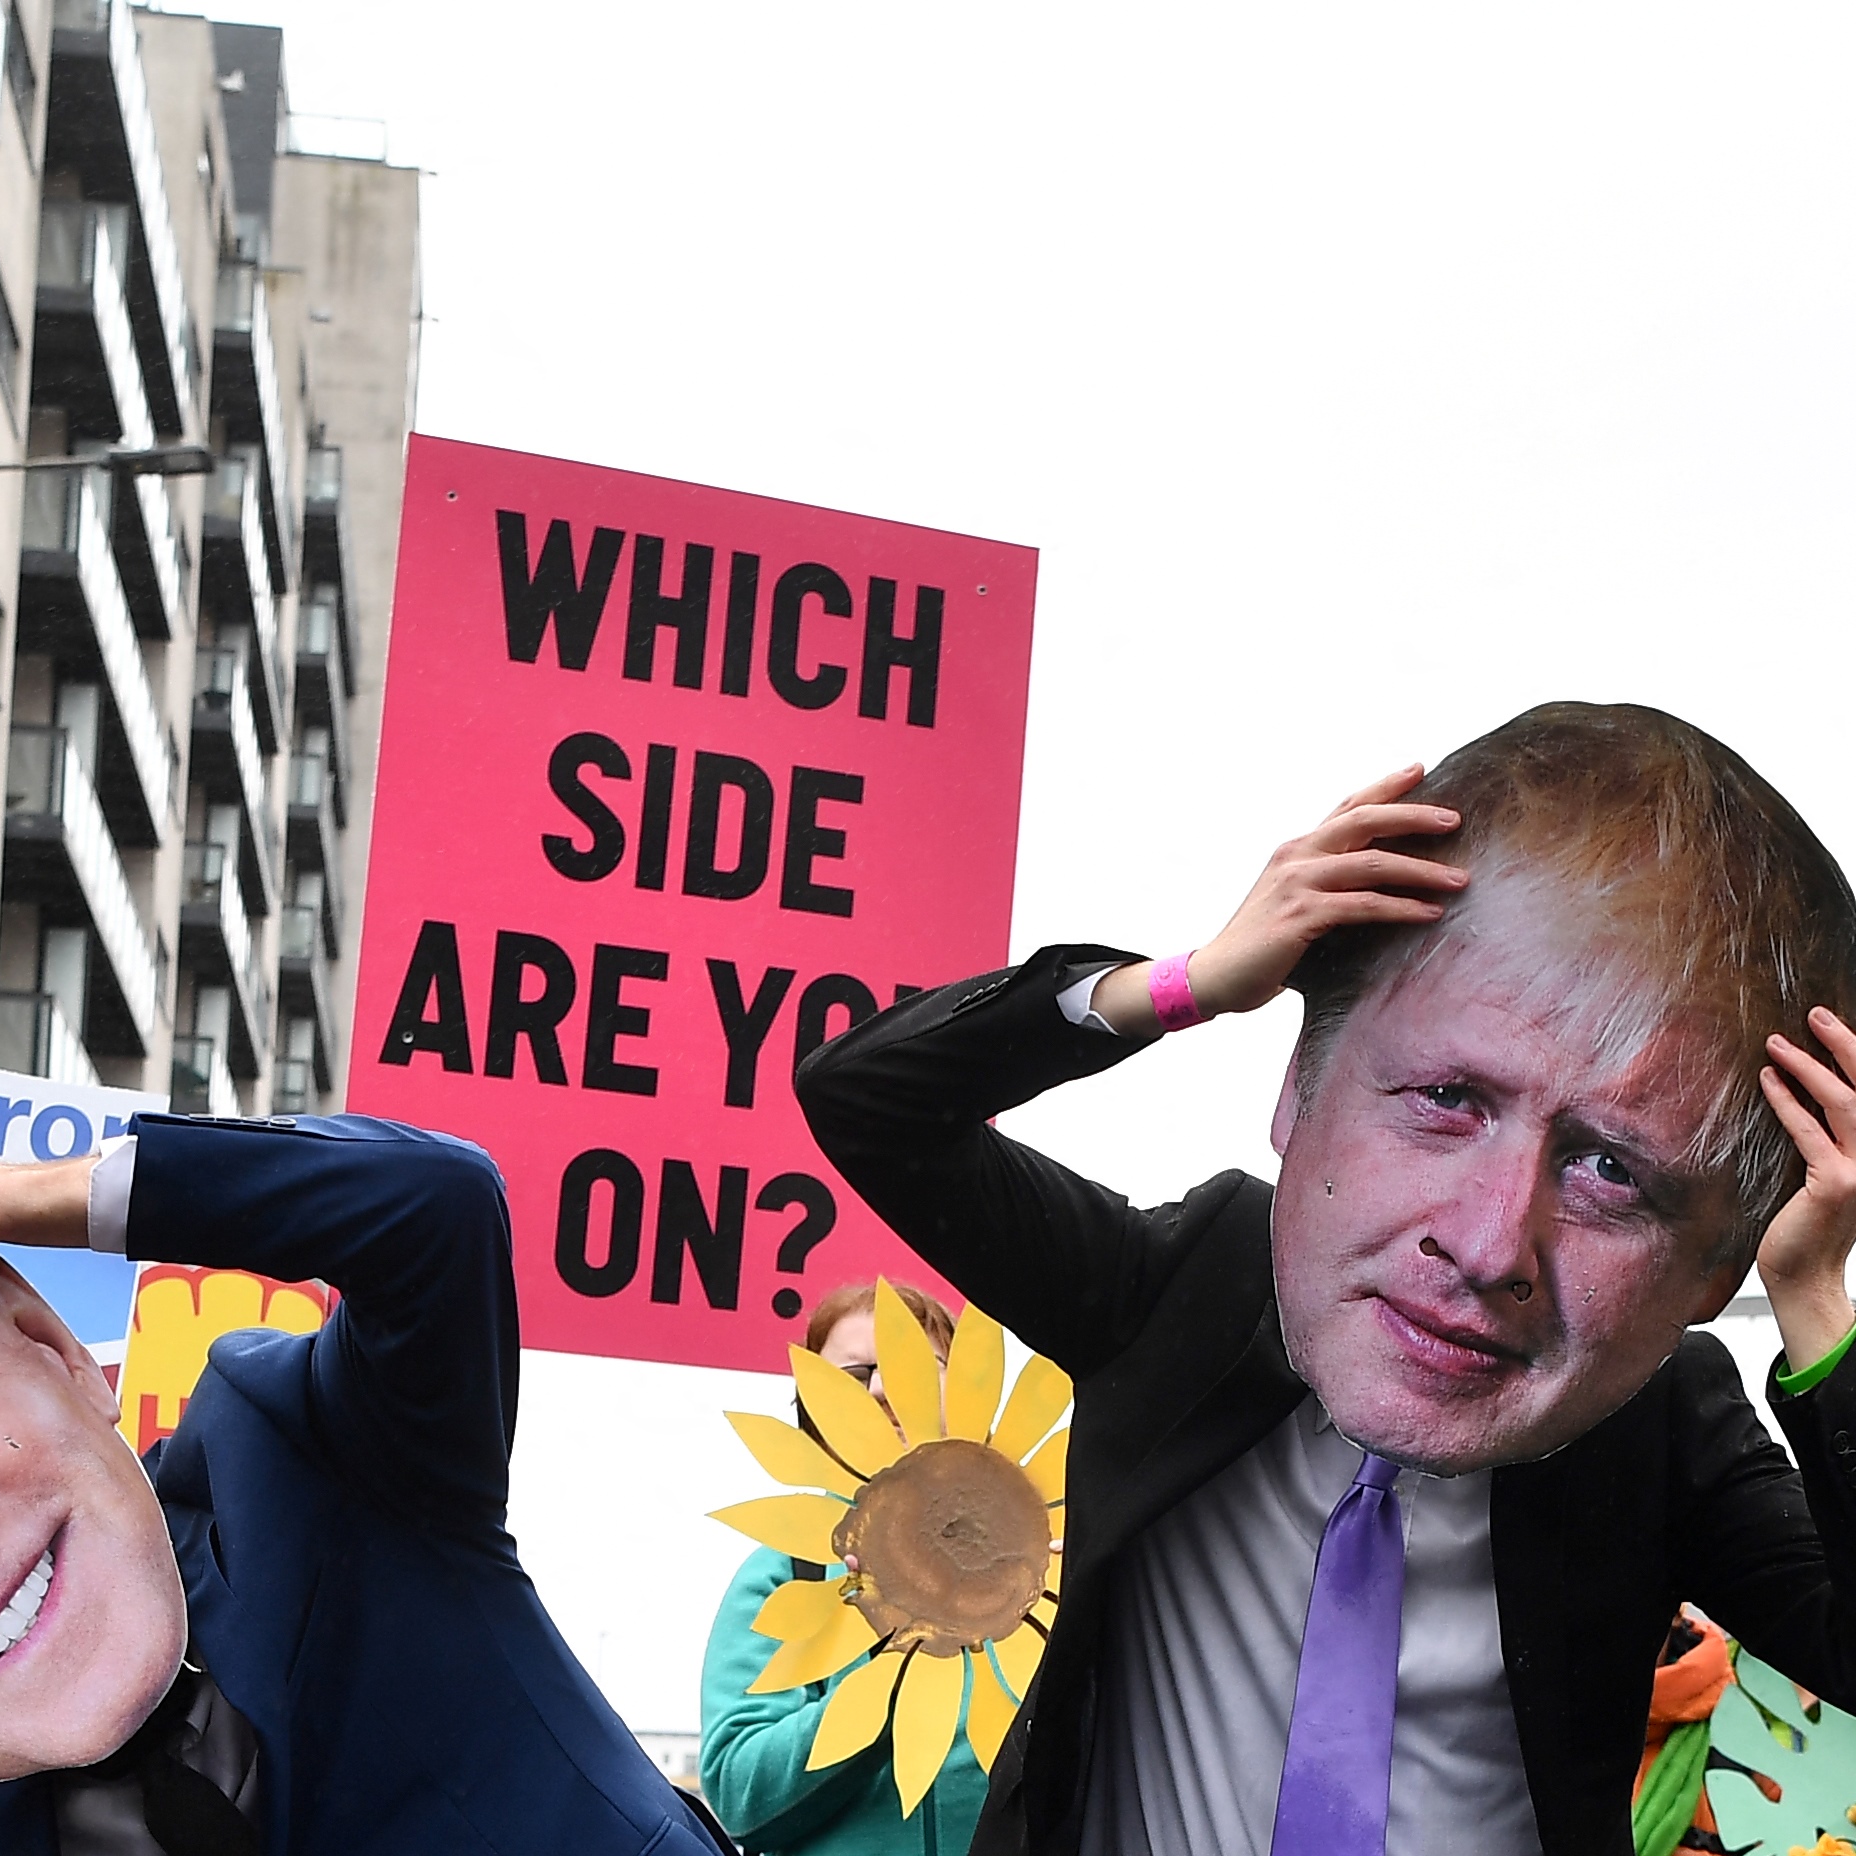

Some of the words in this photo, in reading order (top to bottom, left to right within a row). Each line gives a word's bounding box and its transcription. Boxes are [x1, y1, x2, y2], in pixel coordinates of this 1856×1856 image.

[495, 508, 946, 730] WHICH
[541, 731, 865, 919] SIDE
[378, 920, 669, 1098] ARE
[705, 957, 948, 1110] YO
[554, 1147, 838, 1321] ON?
